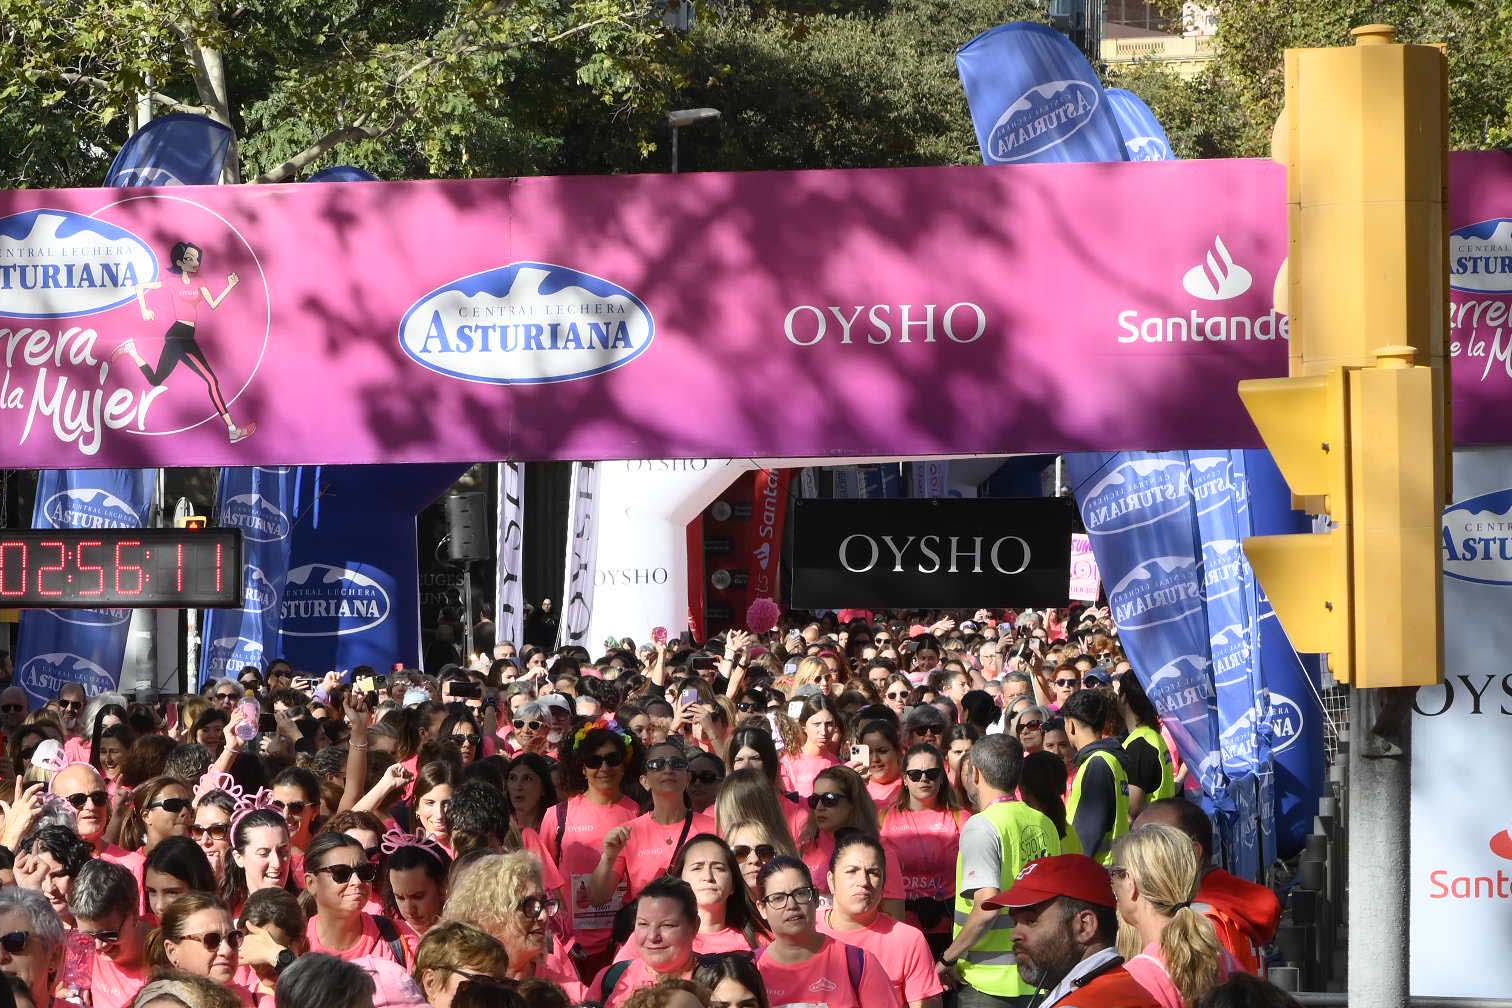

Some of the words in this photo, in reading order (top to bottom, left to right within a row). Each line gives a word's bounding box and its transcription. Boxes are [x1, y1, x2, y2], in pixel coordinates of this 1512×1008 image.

[60, 245, 134, 259] LECHERA
[457, 304, 536, 317] CENTRAL
[542, 303, 626, 316] LECHERA
[782, 302, 987, 346] OYSHO
[1117, 309, 1289, 344] Santande
[419, 308, 636, 355] ASTURIANA
[0, 369, 24, 410] la
[19, 360, 169, 455] Mujer
[759, 470, 781, 538] Santa
[1464, 521, 1512, 533] CENTR
[0, 541, 223, 597] 02:56:11
[838, 533, 1032, 575] OYSHO
[278, 599, 381, 619] STURIANA
[287, 588, 323, 597] ENTRAL
[1429, 869, 1512, 900] Santa
